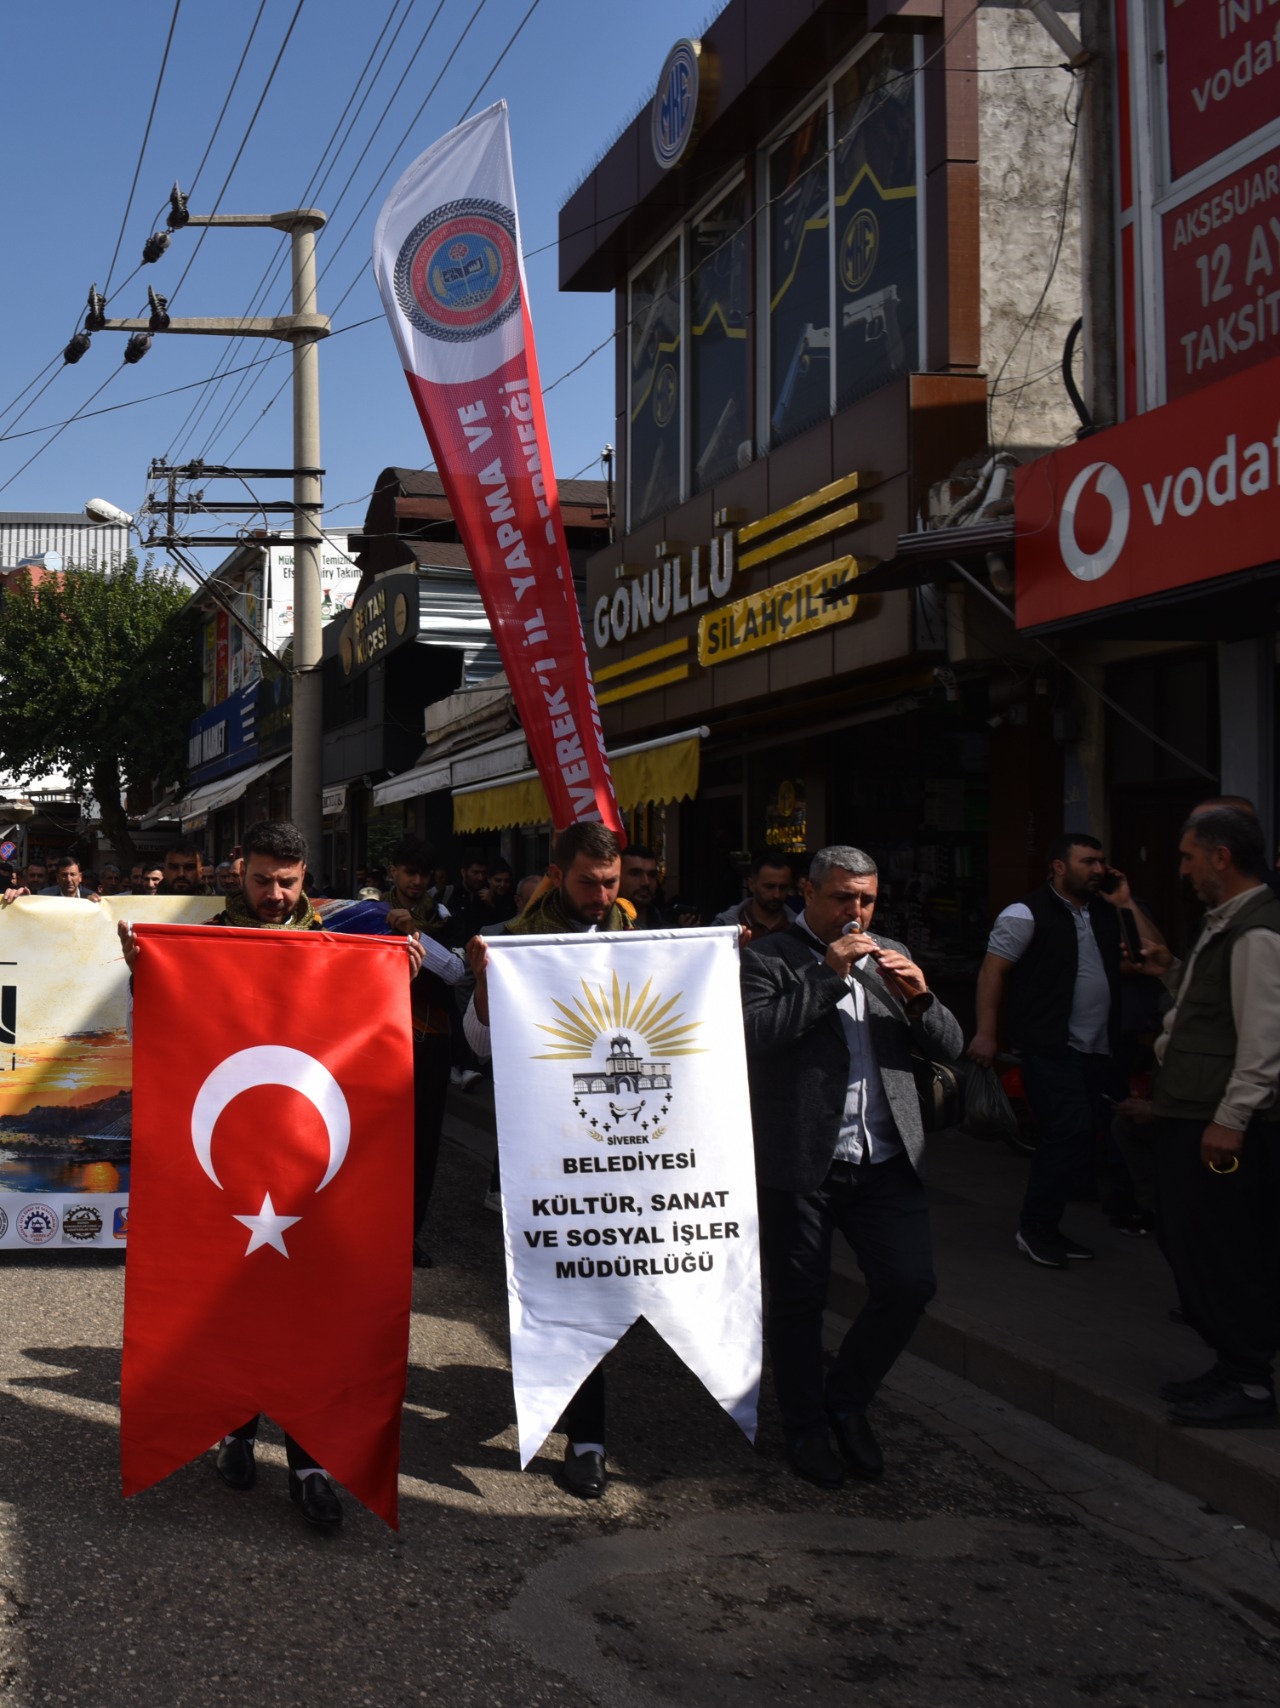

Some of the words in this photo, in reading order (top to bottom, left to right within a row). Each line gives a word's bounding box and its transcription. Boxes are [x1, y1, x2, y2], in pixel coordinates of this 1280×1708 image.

[1195, 243, 1232, 308] 12
[457, 400, 494, 454] VE
[478, 457, 537, 602] YAPMA
[593, 507, 734, 648] GÖNÜLLÜ
[522, 608, 549, 647] İL
[531, 657, 604, 825] İVEREK'İ
[607, 1135, 650, 1146] SİVEREK
[562, 1148, 696, 1174] BELEDİYESİ
[532, 1193, 644, 1216] KÜLTÜR,
[650, 1190, 730, 1212] SANAT
[523, 1229, 559, 1249] VE
[566, 1226, 665, 1247] SOSYAL
[672, 1221, 741, 1246] İŞLER
[555, 1251, 714, 1279] MÜDÜRLÜĞÜ
